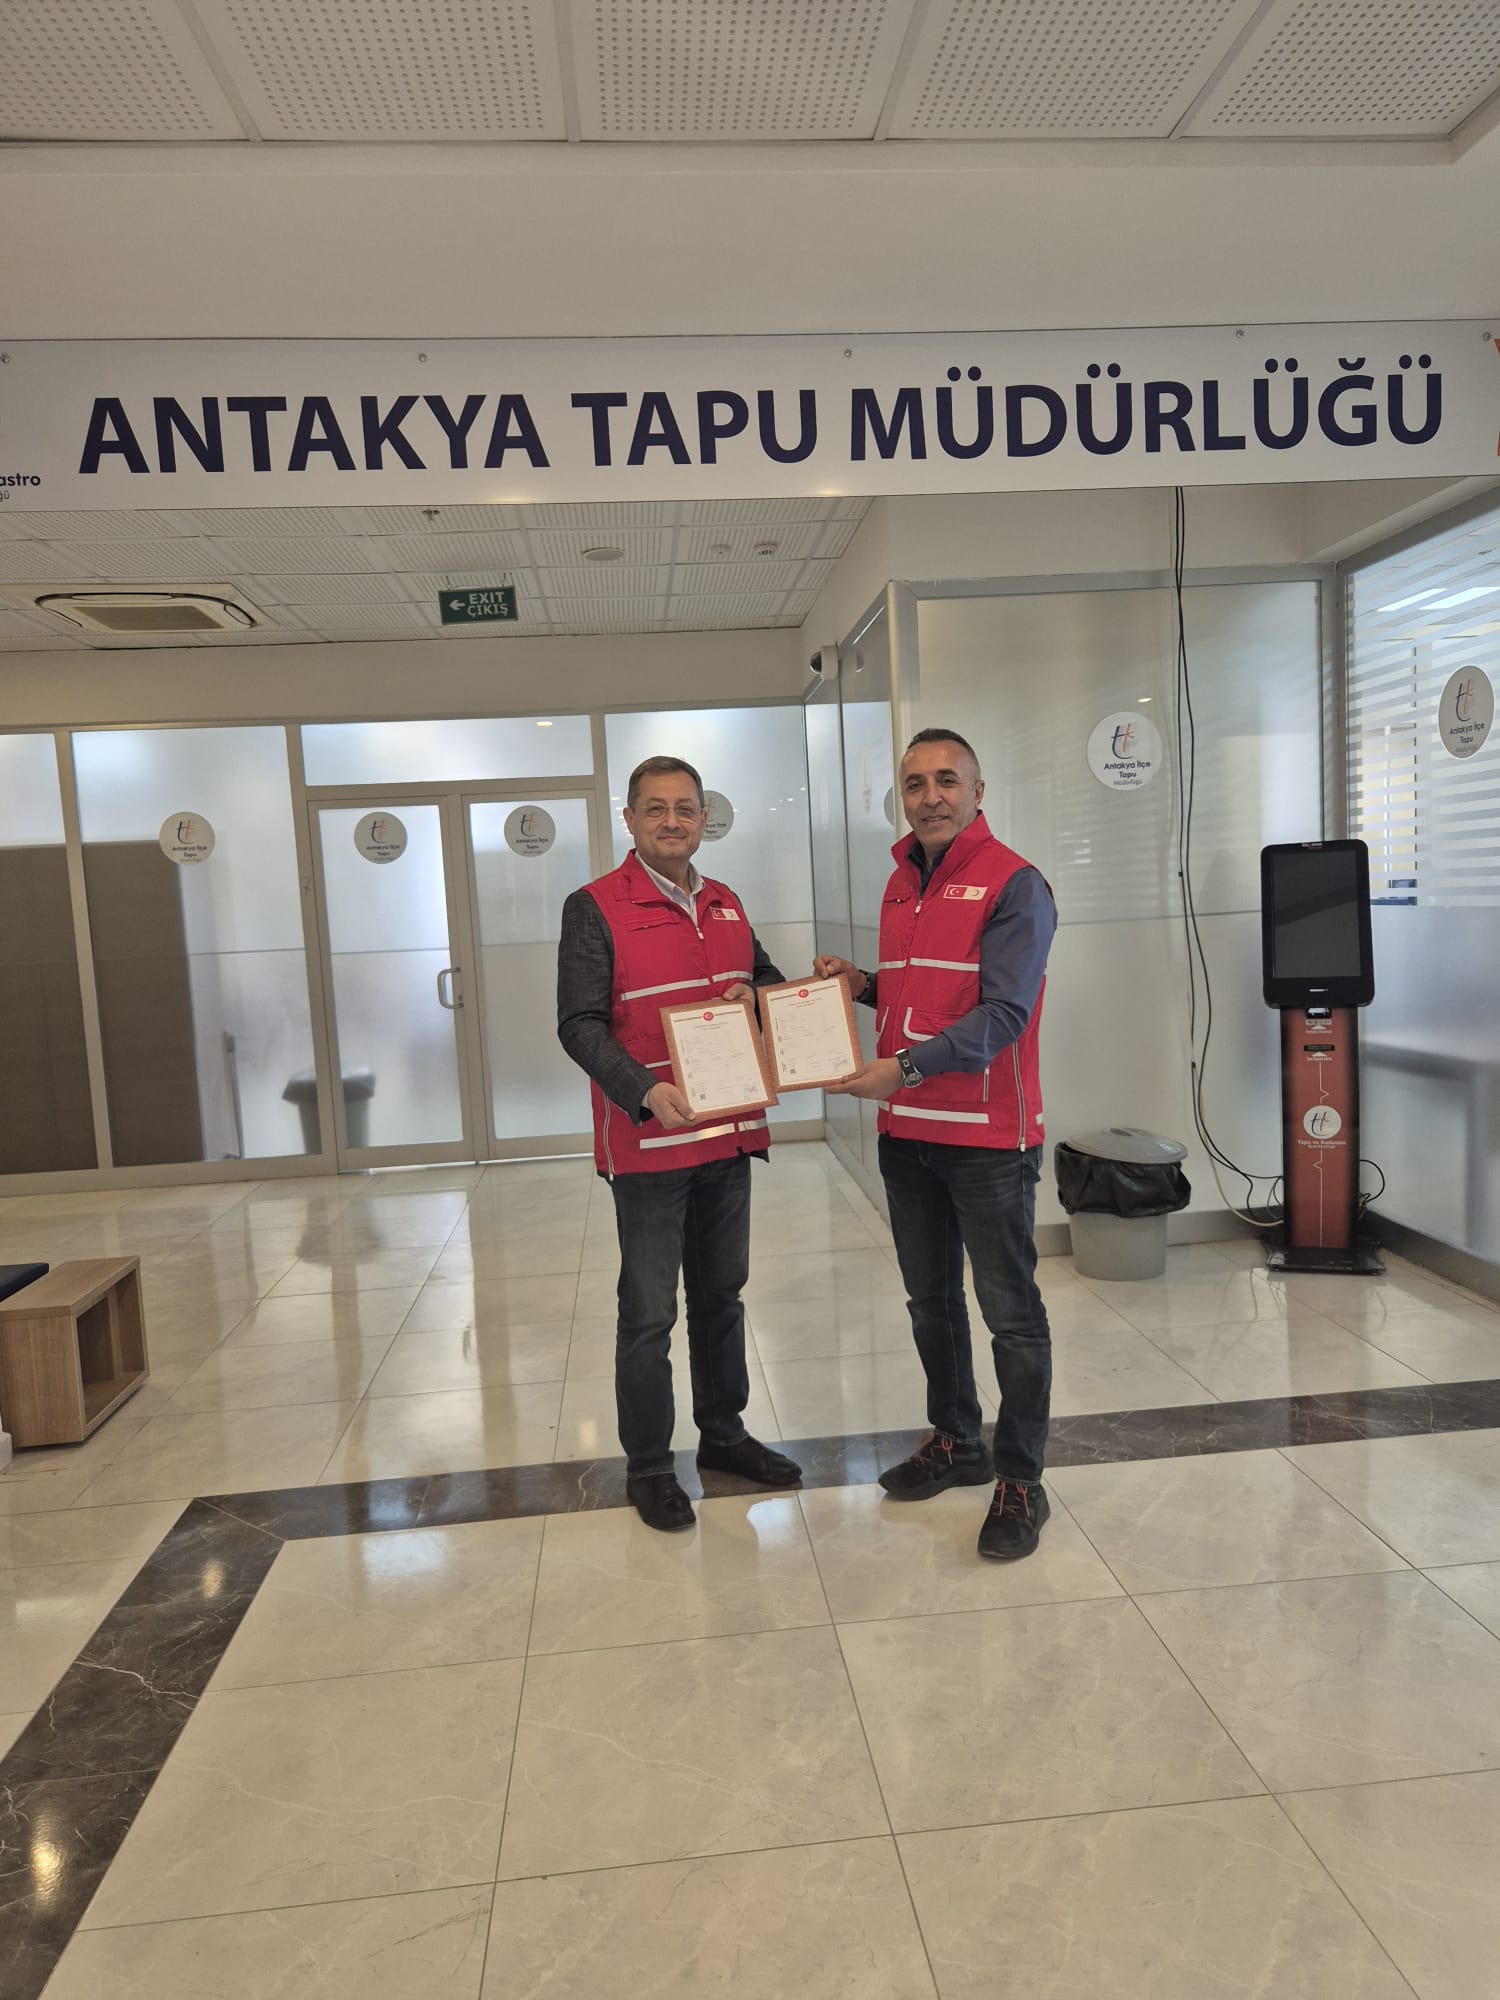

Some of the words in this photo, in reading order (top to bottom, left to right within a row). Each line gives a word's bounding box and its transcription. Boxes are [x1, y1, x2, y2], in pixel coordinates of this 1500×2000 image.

[79, 394, 551, 474] ANTAKYA
[571, 389, 818, 467] TAPU
[850, 354, 1443, 461] MÜDÜRLÜĞÜ
[469, 592, 504, 604] EXIT
[467, 603, 509, 618] ÇIKIŞ
[1104, 762, 1136, 770] Antakya
[1119, 771, 1137, 779] Tapu
